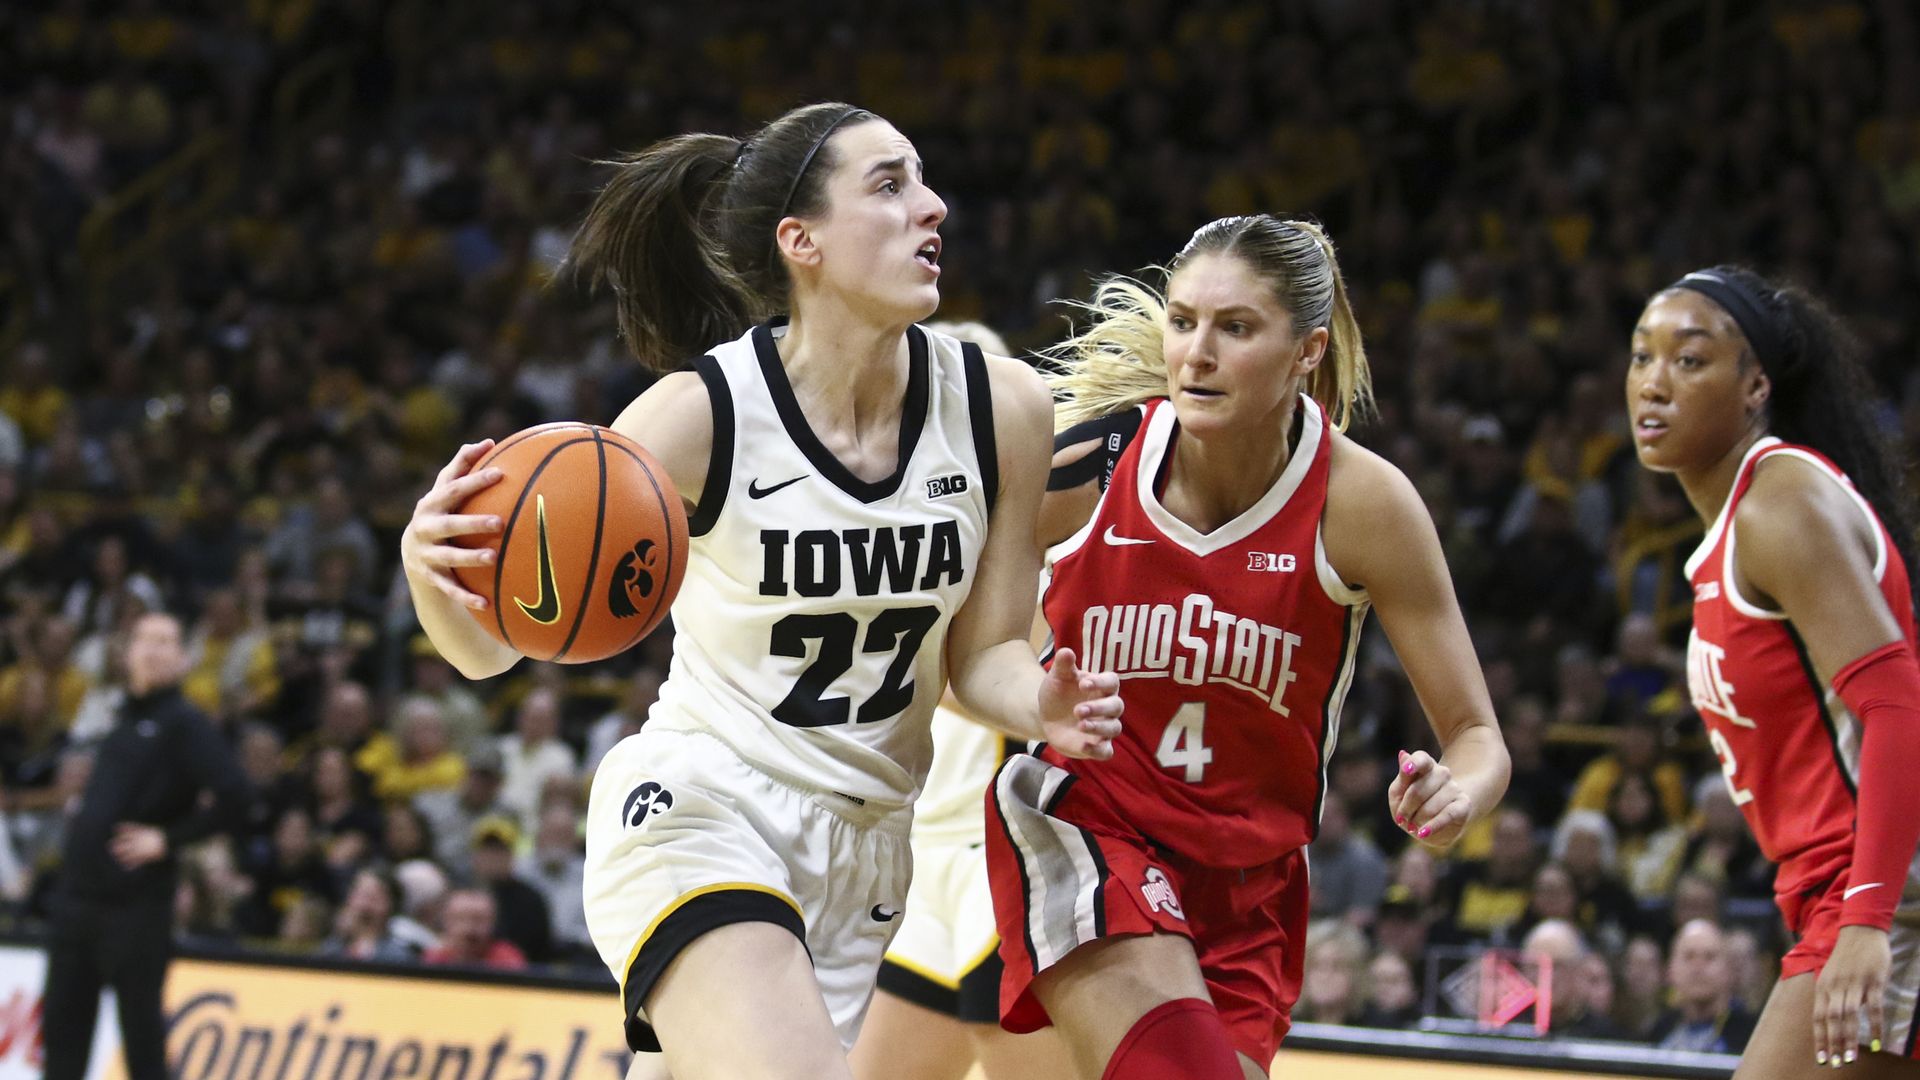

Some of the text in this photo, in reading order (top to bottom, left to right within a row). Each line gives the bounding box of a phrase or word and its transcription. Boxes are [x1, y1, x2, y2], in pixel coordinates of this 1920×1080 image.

[759, 519, 964, 597] IOWA
[769, 605, 941, 728] 22
[1155, 702, 1213, 783] 4
